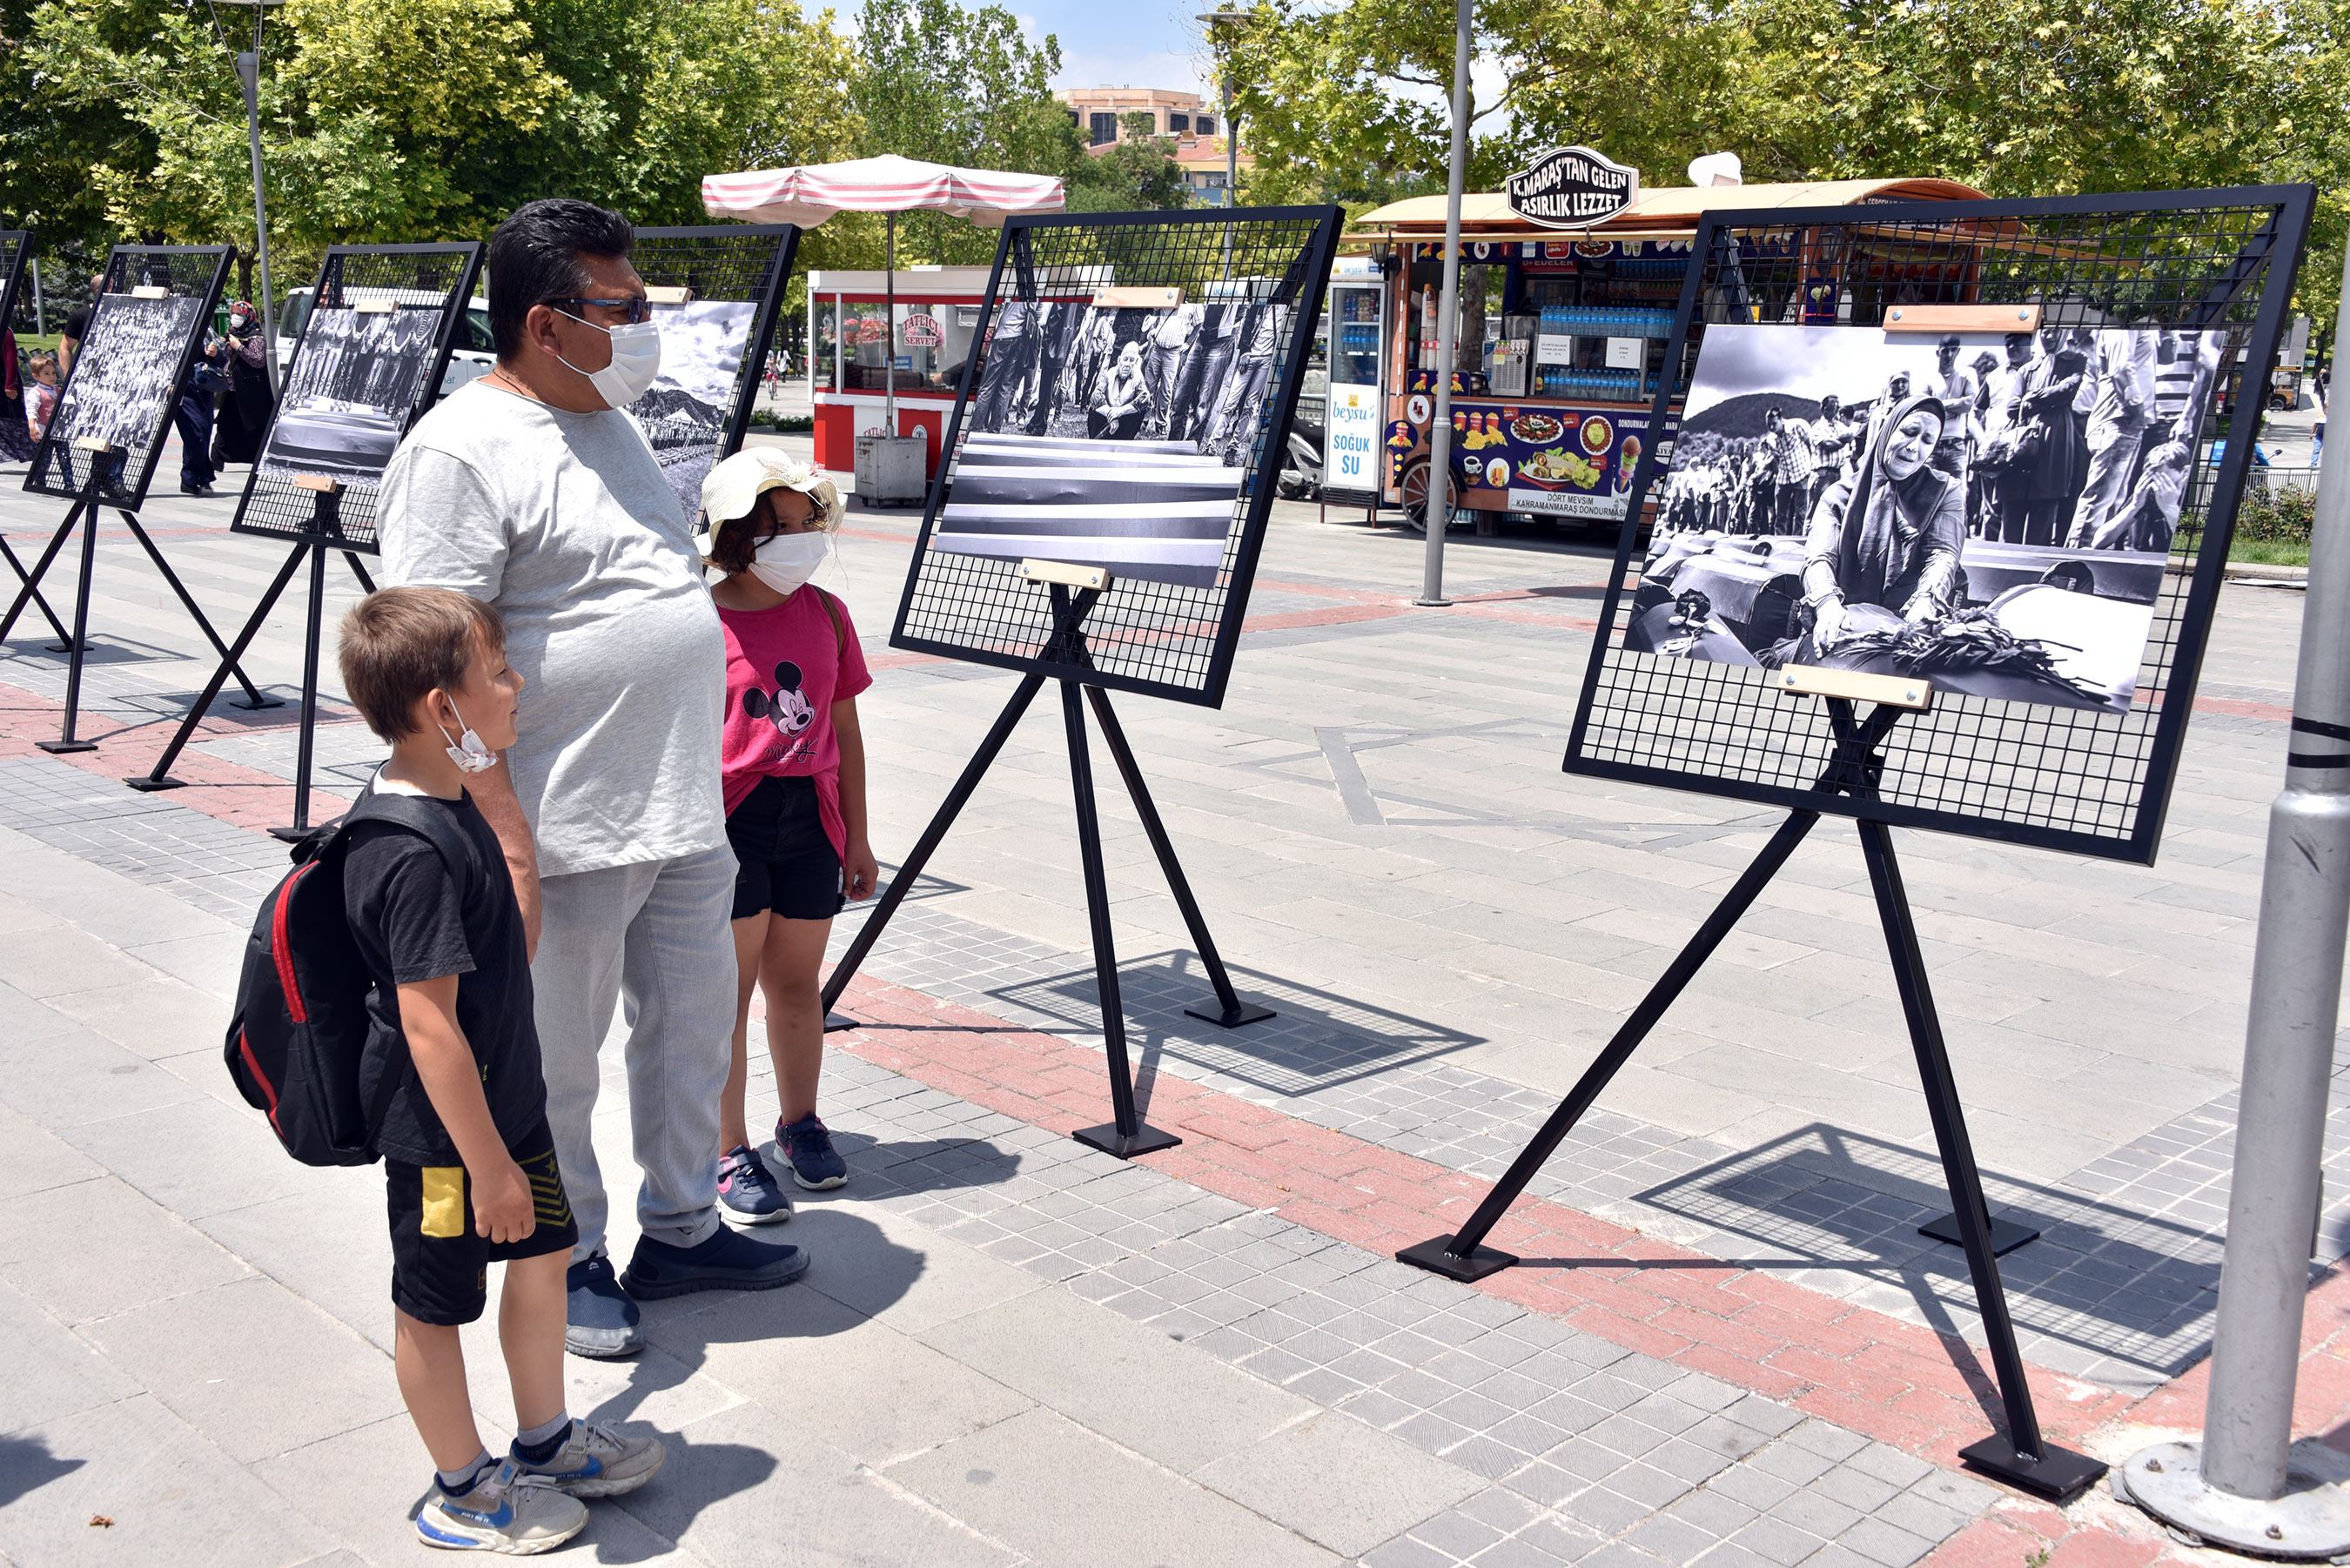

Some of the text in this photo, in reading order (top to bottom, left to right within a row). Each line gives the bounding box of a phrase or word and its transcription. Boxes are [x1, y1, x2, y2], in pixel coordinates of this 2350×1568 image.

[1513, 157, 1627, 197] K.MARAŞ'TAN GELEN
[1521, 192, 1622, 217] ASIRLIK LEZZET
[903, 314, 938, 333] TATLICI
[905, 336, 937, 345] SERVET
[1333, 401, 1367, 423] beysu
[1333, 432, 1370, 452] SOĞUK
[1341, 454, 1360, 475] SU
[1548, 492, 1566, 502] DÖRT
[1516, 499, 1626, 517] KAHRAMANMARAŞ DONDURMASI
